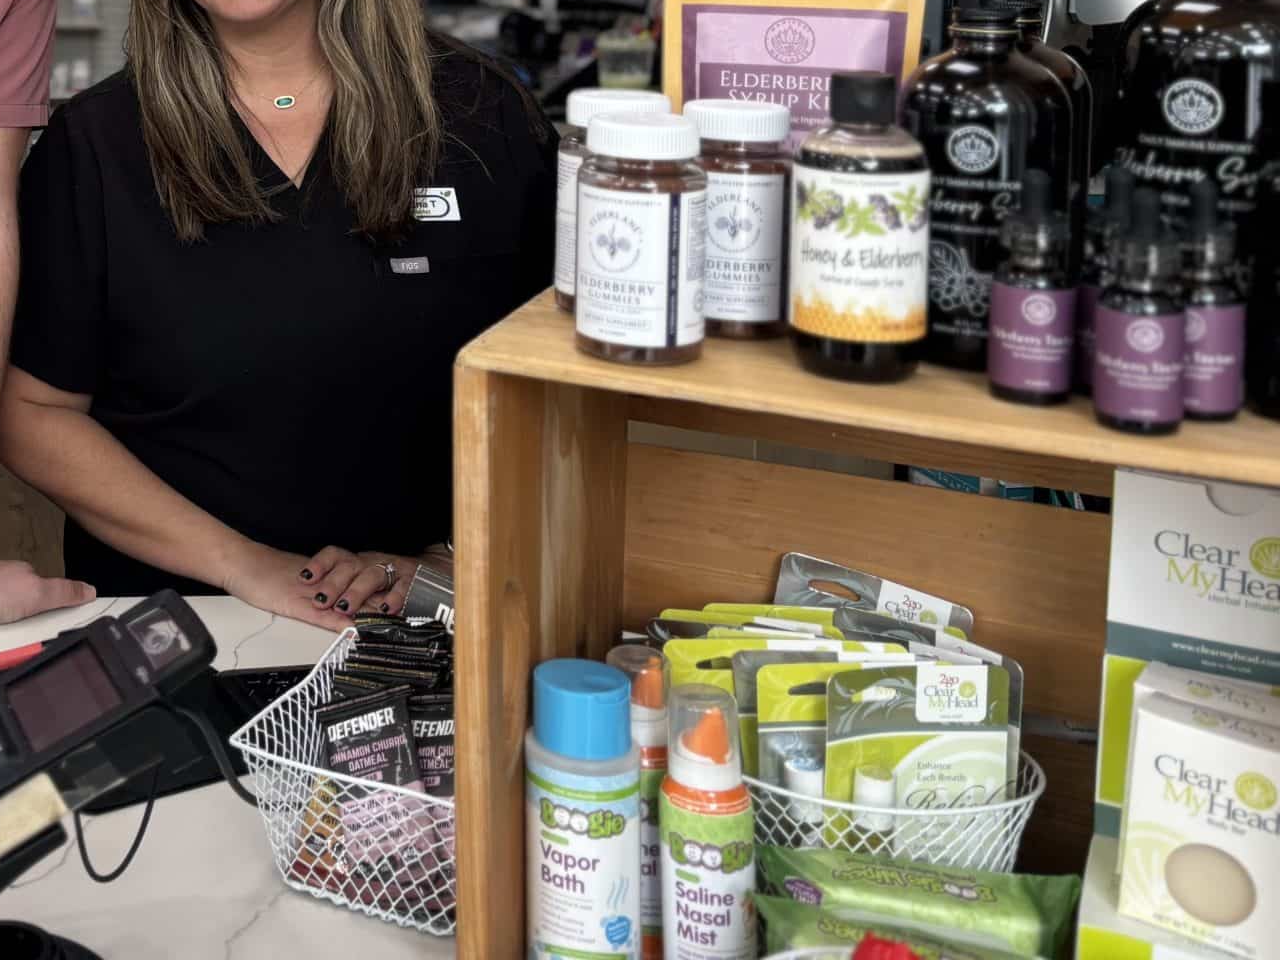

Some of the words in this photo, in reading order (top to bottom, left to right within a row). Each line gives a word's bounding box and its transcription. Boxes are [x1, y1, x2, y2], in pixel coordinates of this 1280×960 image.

[720, 70, 831, 91] ELDERBER
[808, 93, 831, 111] KI
[706, 259, 771, 273] DERBERRY
[1153, 528, 1240, 567] Clear
[1166, 556, 1280, 602] MyHea
[327, 707, 396, 742] DEFENDER
[412, 720, 455, 737] EFEND
[348, 752, 387, 772] OATMEAL
[1153, 752, 1229, 794] Clear
[540, 839, 600, 872] Vapor
[540, 863, 585, 894] Bath
[675, 881, 735, 907] Saline
[675, 901, 731, 926] Nasal
[676, 921, 718, 945] Mist
